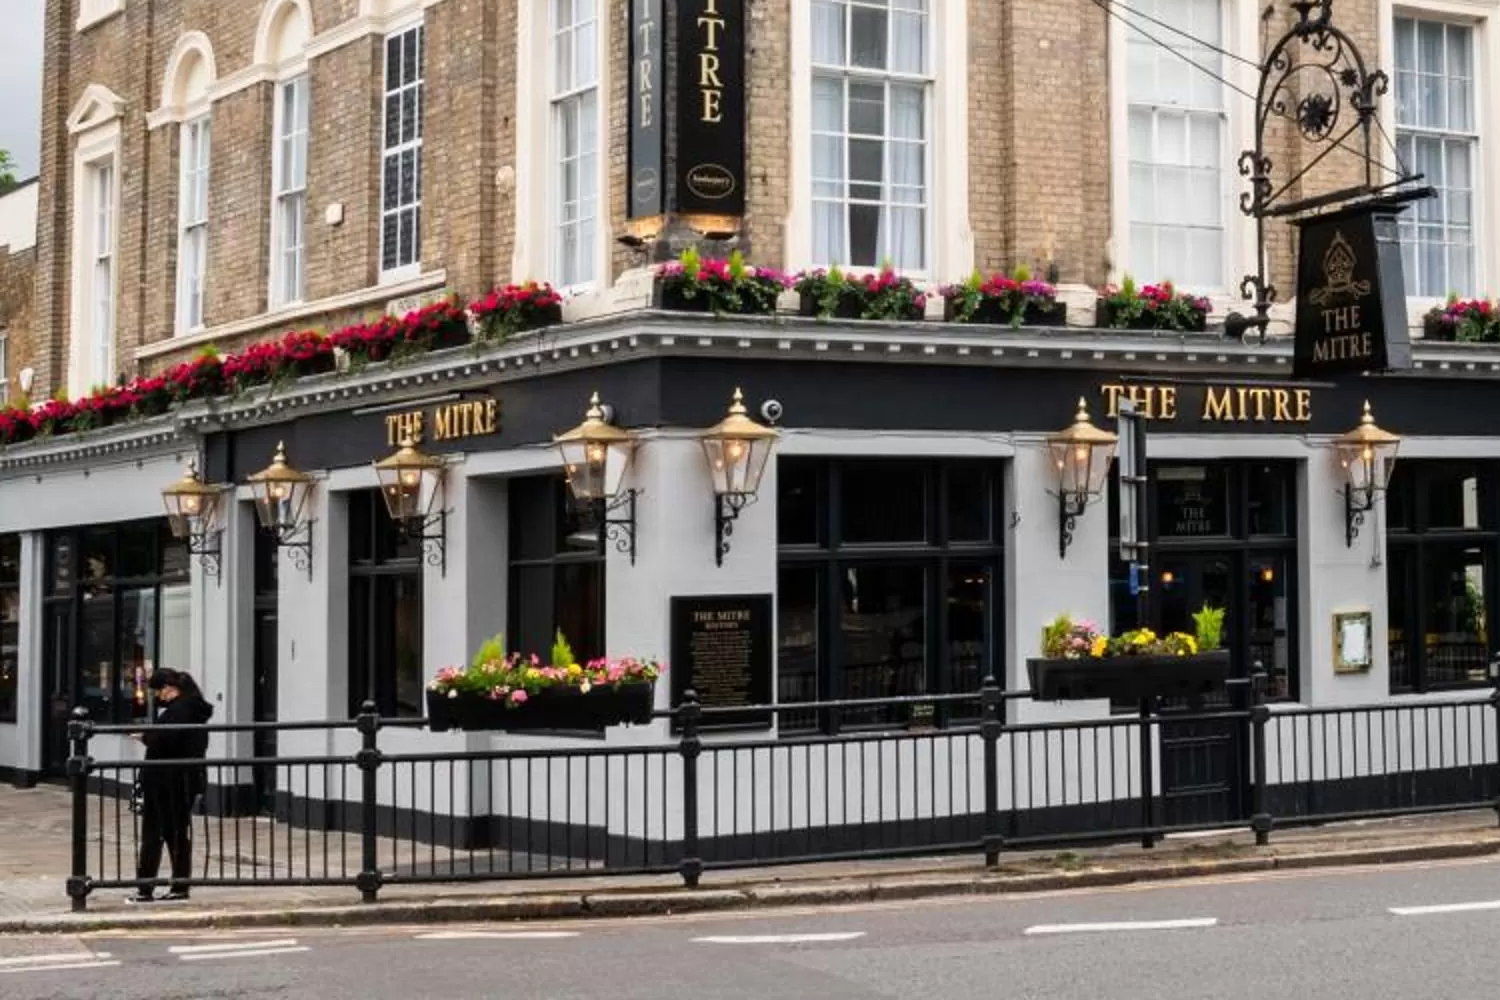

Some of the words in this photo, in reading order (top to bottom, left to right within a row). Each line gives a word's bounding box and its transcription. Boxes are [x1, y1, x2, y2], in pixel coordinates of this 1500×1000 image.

[1321, 305, 1361, 333] THE
[1312, 332, 1372, 363] MITRE
[1101, 385, 1177, 419] THE
[1201, 386, 1313, 422] MITRE
[385, 411, 424, 447] THE
[433, 399, 498, 441] MITRE
[694, 611, 713, 621] THE
[717, 609, 751, 620] MITRE
